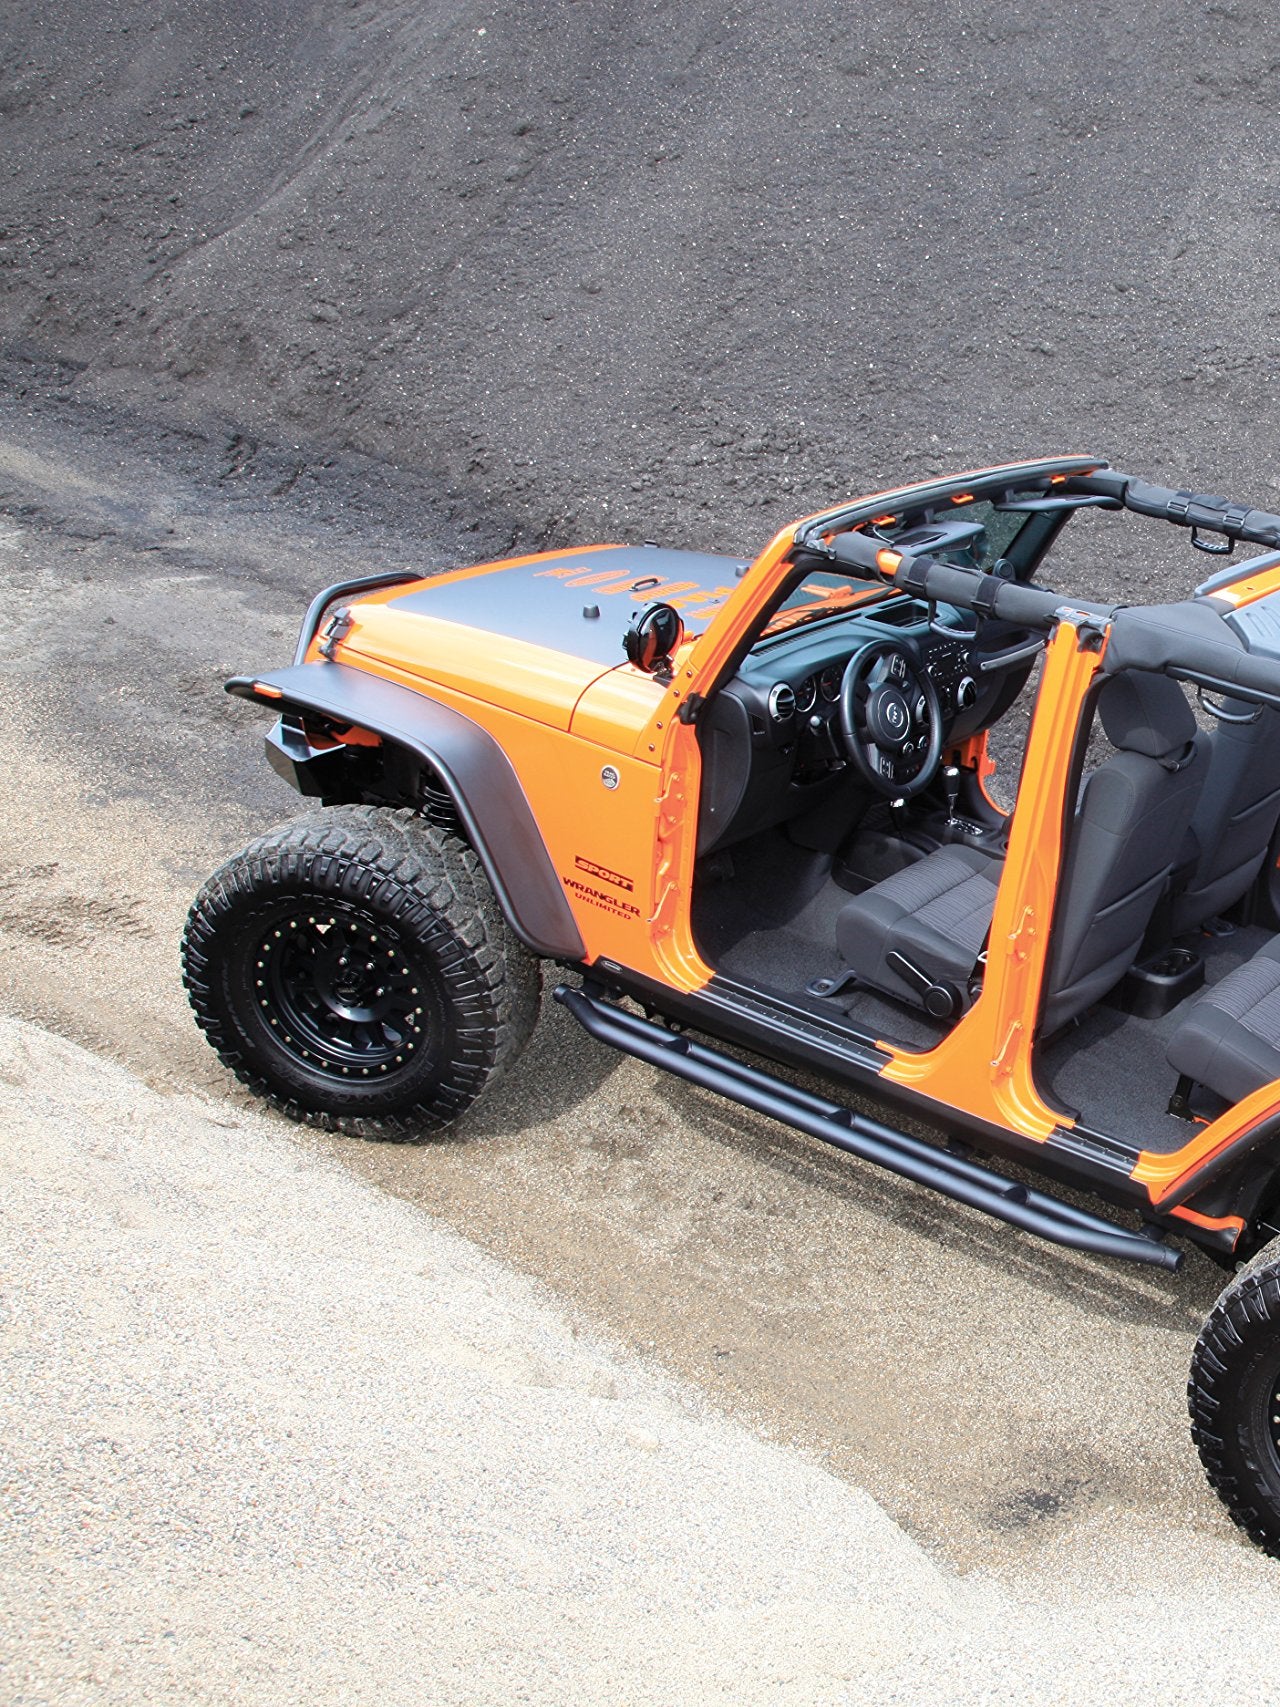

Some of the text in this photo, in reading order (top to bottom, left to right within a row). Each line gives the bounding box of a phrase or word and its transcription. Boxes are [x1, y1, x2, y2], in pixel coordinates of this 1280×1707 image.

[575, 858, 632, 890] SPORT
[562, 876, 641, 918] WRANGLER
[574, 892, 632, 920] UNLIMITED
